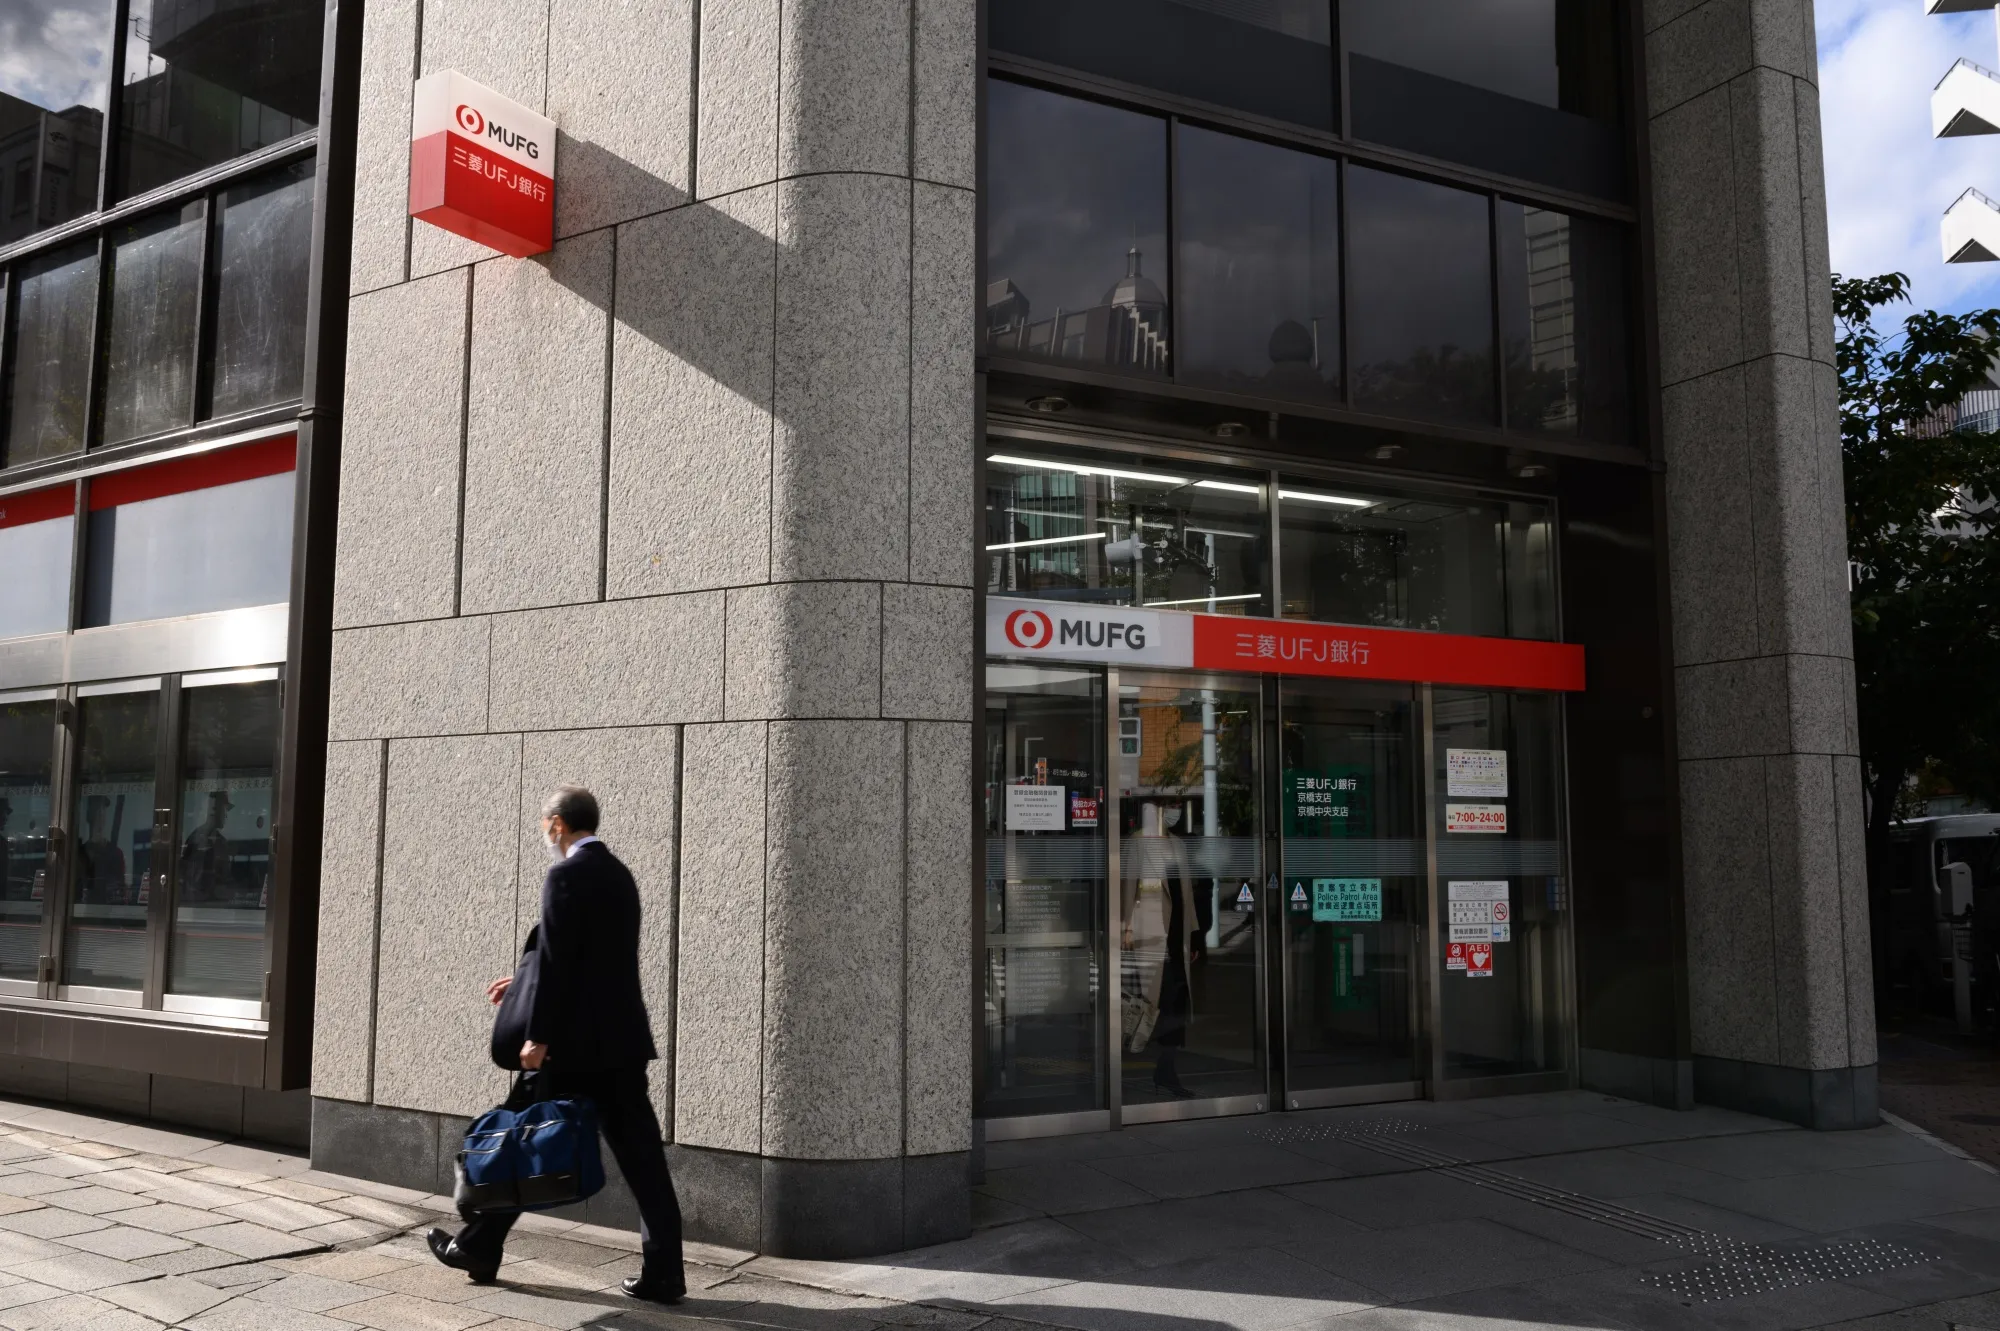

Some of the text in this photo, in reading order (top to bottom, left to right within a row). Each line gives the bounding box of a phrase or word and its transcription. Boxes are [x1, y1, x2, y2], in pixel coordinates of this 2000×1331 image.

[488, 121, 539, 160] MUFG
[453, 146, 546, 203] 三菱UFJ銀行
[1060, 618, 1147, 650] MUFG
[1234, 632, 1370, 666] 三菱UFJ銀行
[1296, 777, 1357, 790] 三菱UFJ銀行
[1297, 792, 1332, 803] 京橋支店
[1297, 806, 1349, 817] 京橋中央支店
[1317, 893, 1378, 901] Police Patrol Area
[1468, 944, 1490, 952] AED
